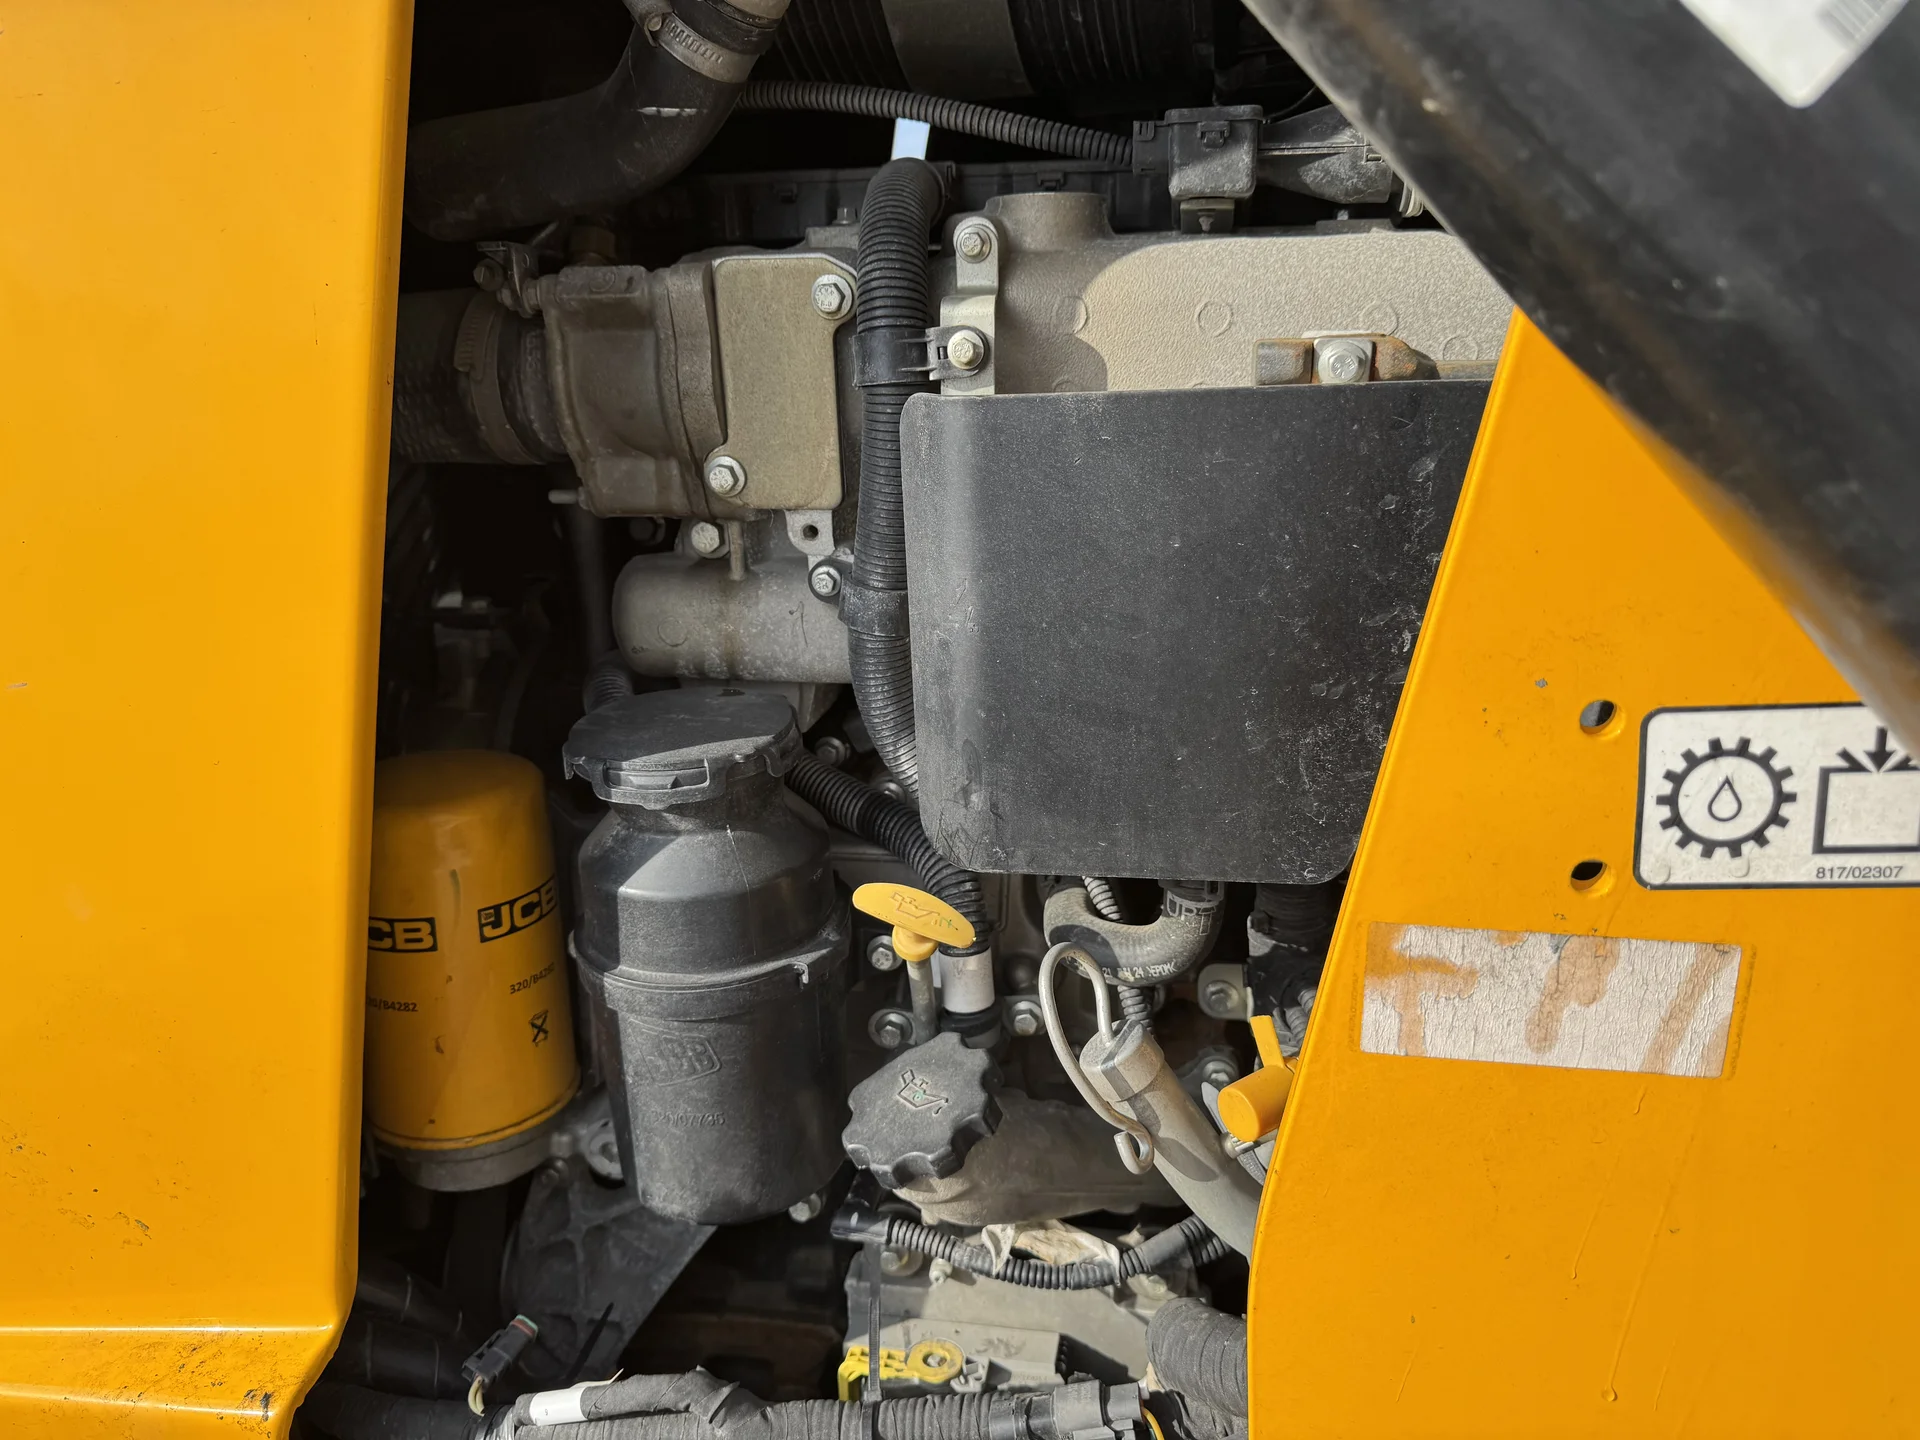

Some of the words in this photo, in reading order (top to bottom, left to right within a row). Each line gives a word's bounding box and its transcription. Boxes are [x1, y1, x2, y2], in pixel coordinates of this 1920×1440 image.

[1816, 866, 1904, 879] 817/02307
[481, 879, 558, 938] JCB
[368, 920, 435, 950] CB
